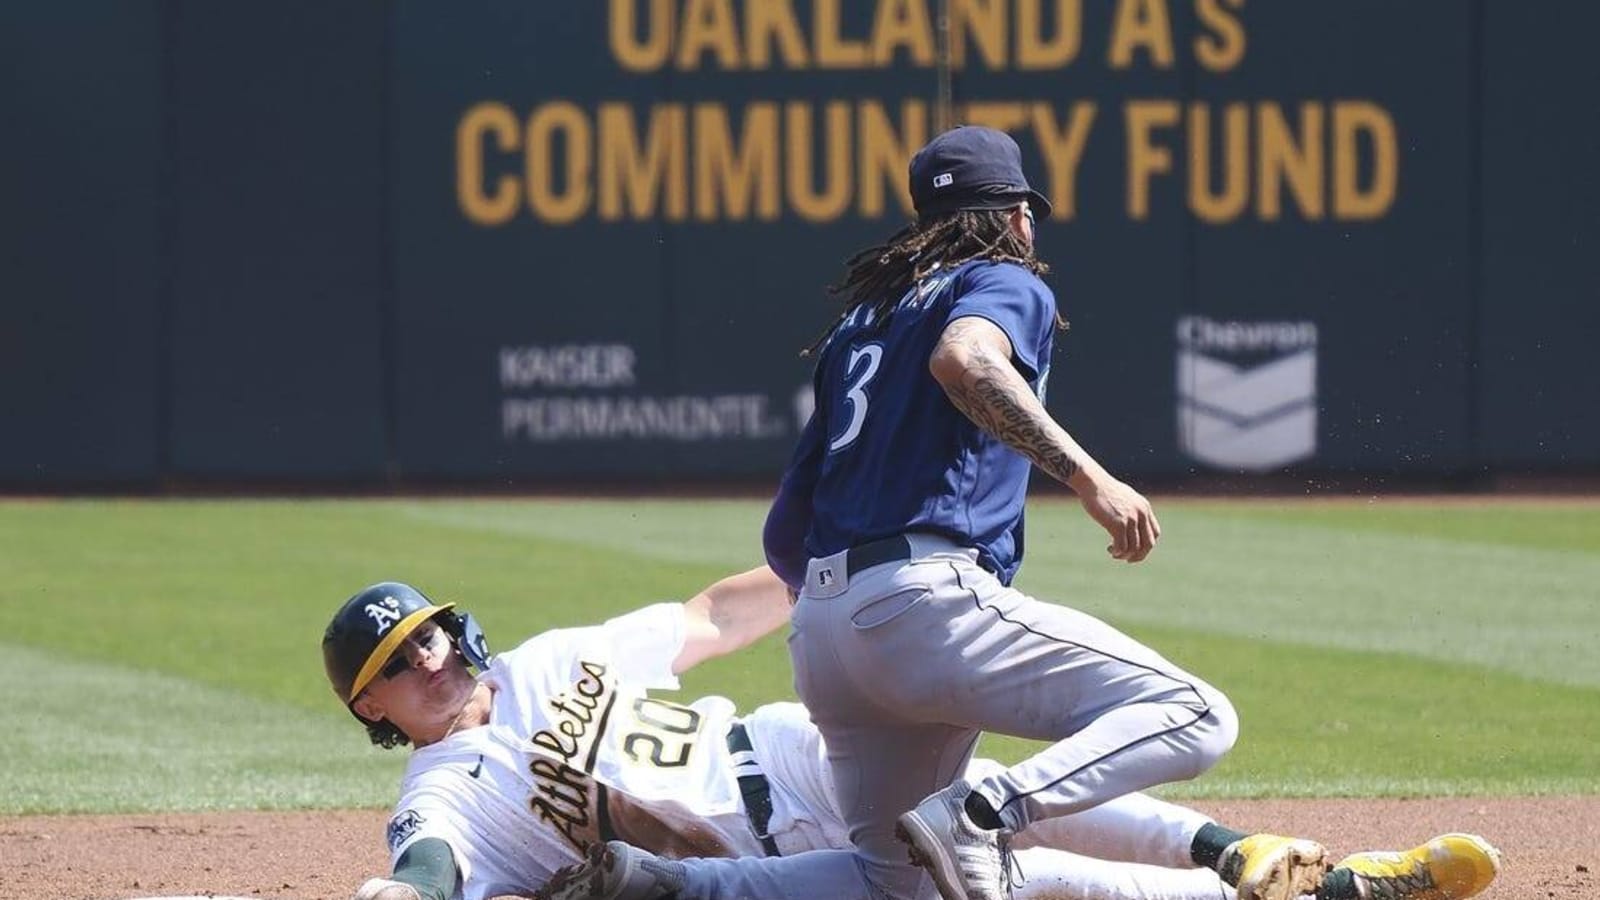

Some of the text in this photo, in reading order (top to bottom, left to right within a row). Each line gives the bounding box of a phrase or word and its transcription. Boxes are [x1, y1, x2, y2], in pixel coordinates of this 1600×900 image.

[456, 101, 1398, 225] COMMUNY FUND
[500, 346, 636, 387] KAISER
[1177, 316, 1318, 350] Chevron
[829, 344, 884, 453] 3
[364, 596, 401, 637] A's
[530, 660, 608, 852] Athletics
[622, 696, 701, 769] 20
